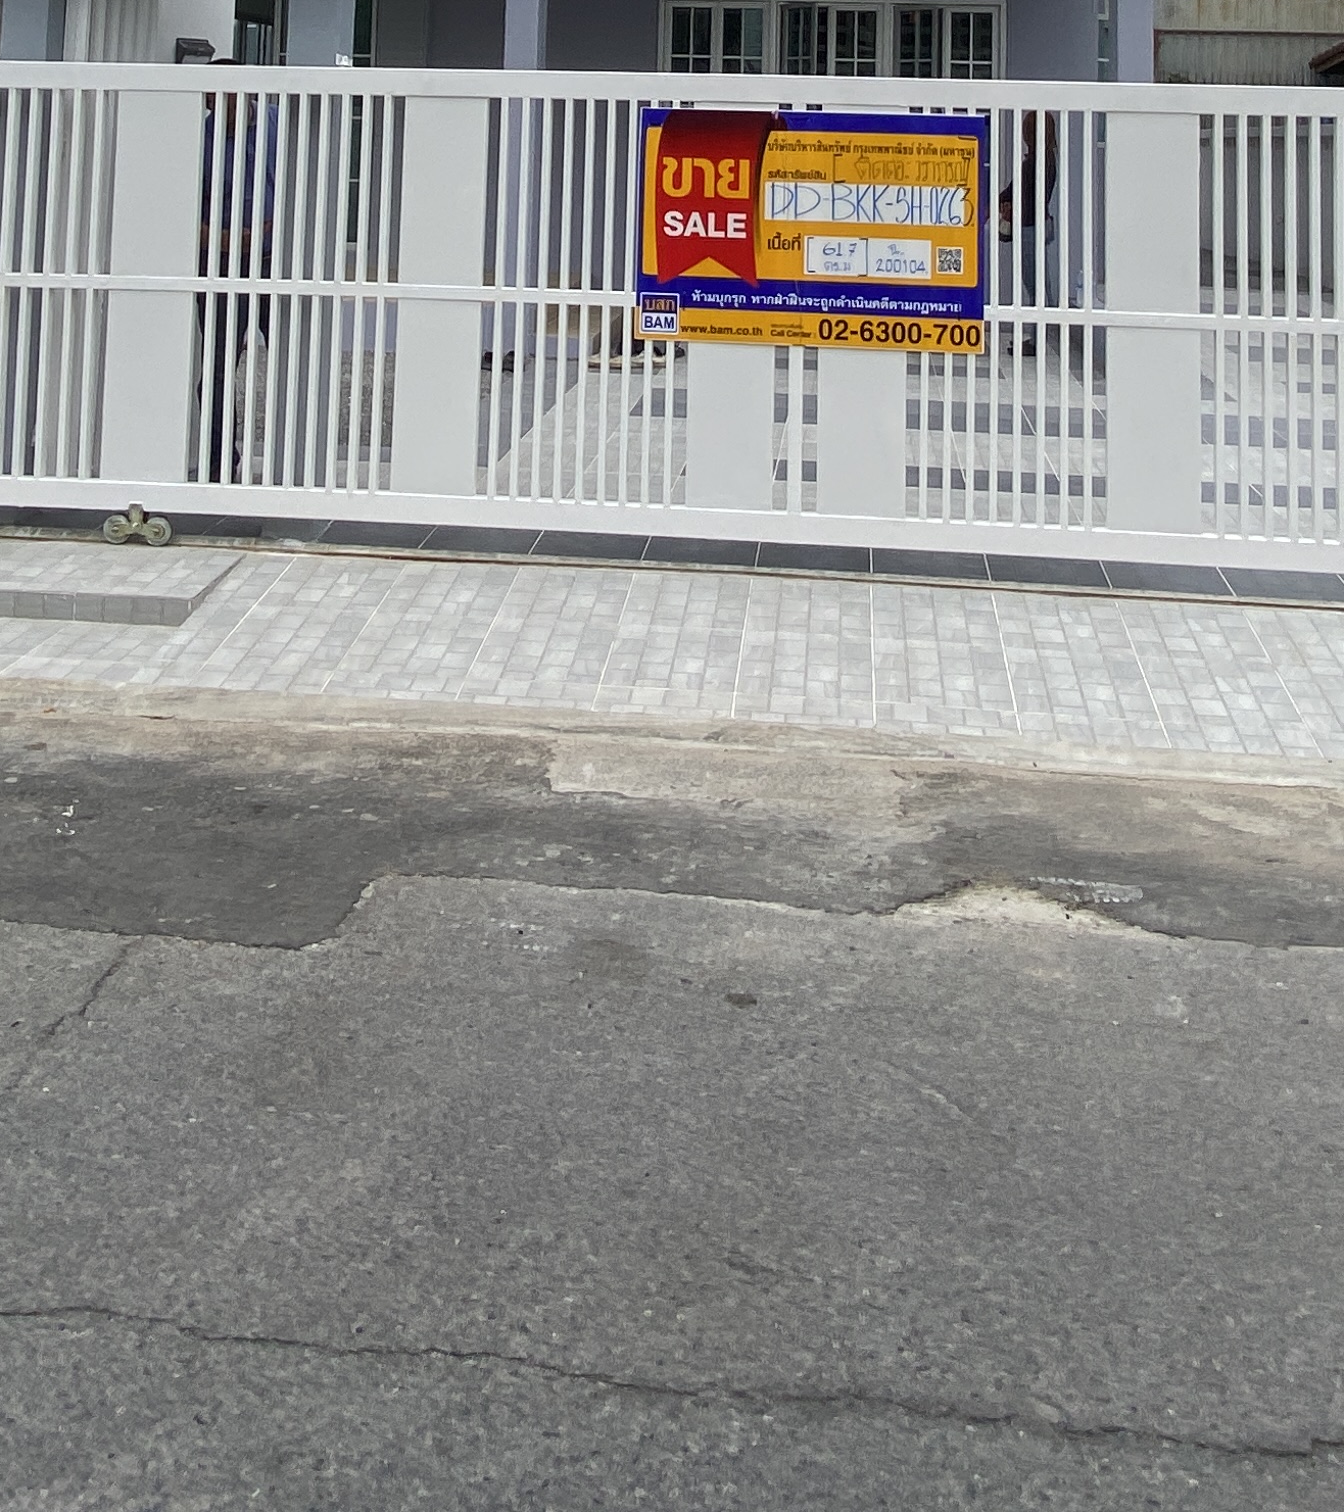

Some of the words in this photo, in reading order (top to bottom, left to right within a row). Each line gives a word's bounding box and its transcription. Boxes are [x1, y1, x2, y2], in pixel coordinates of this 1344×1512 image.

[662, 156, 751, 200] ขาย
[663, 210, 747, 239] SALE
[767, 232, 802, 252] เนื้อที่
[691, 289, 747, 308] ห้ามบุกรุก
[644, 315, 675, 330] BAM
[680, 324, 763, 337] www.bam.co.th
[770, 329, 786, 338] Call
[818, 318, 981, 348] 02-6300-700
